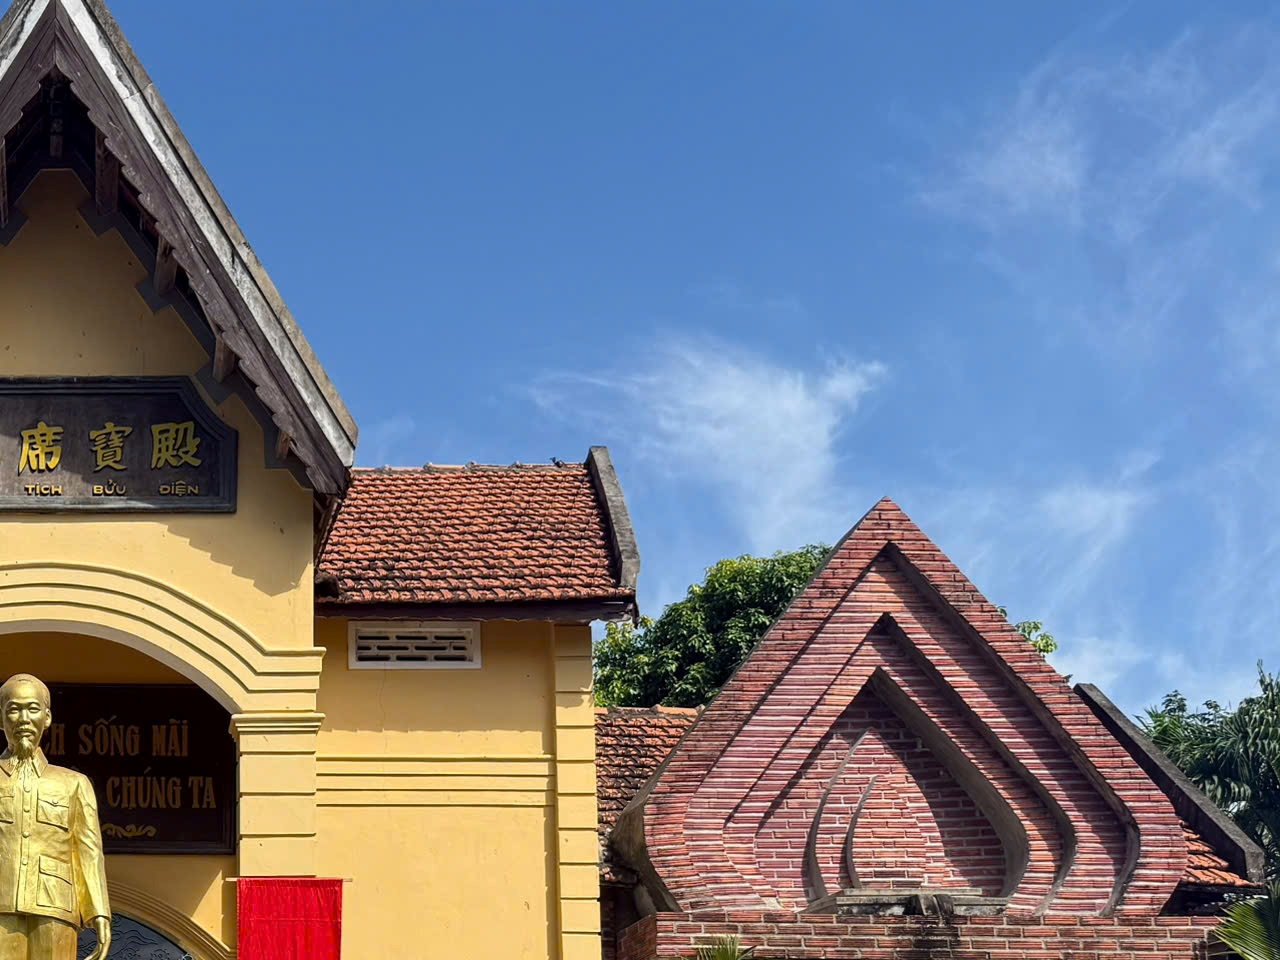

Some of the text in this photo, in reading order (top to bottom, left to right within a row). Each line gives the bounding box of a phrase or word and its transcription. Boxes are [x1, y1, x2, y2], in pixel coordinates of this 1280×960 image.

[93, 479, 126, 494] BỬU
[159, 481, 199, 496] ĐIỆN
[78, 715, 140, 756] SỐNG
[106, 766, 182, 809] CHÚNG
[188, 775, 216, 808] TA
